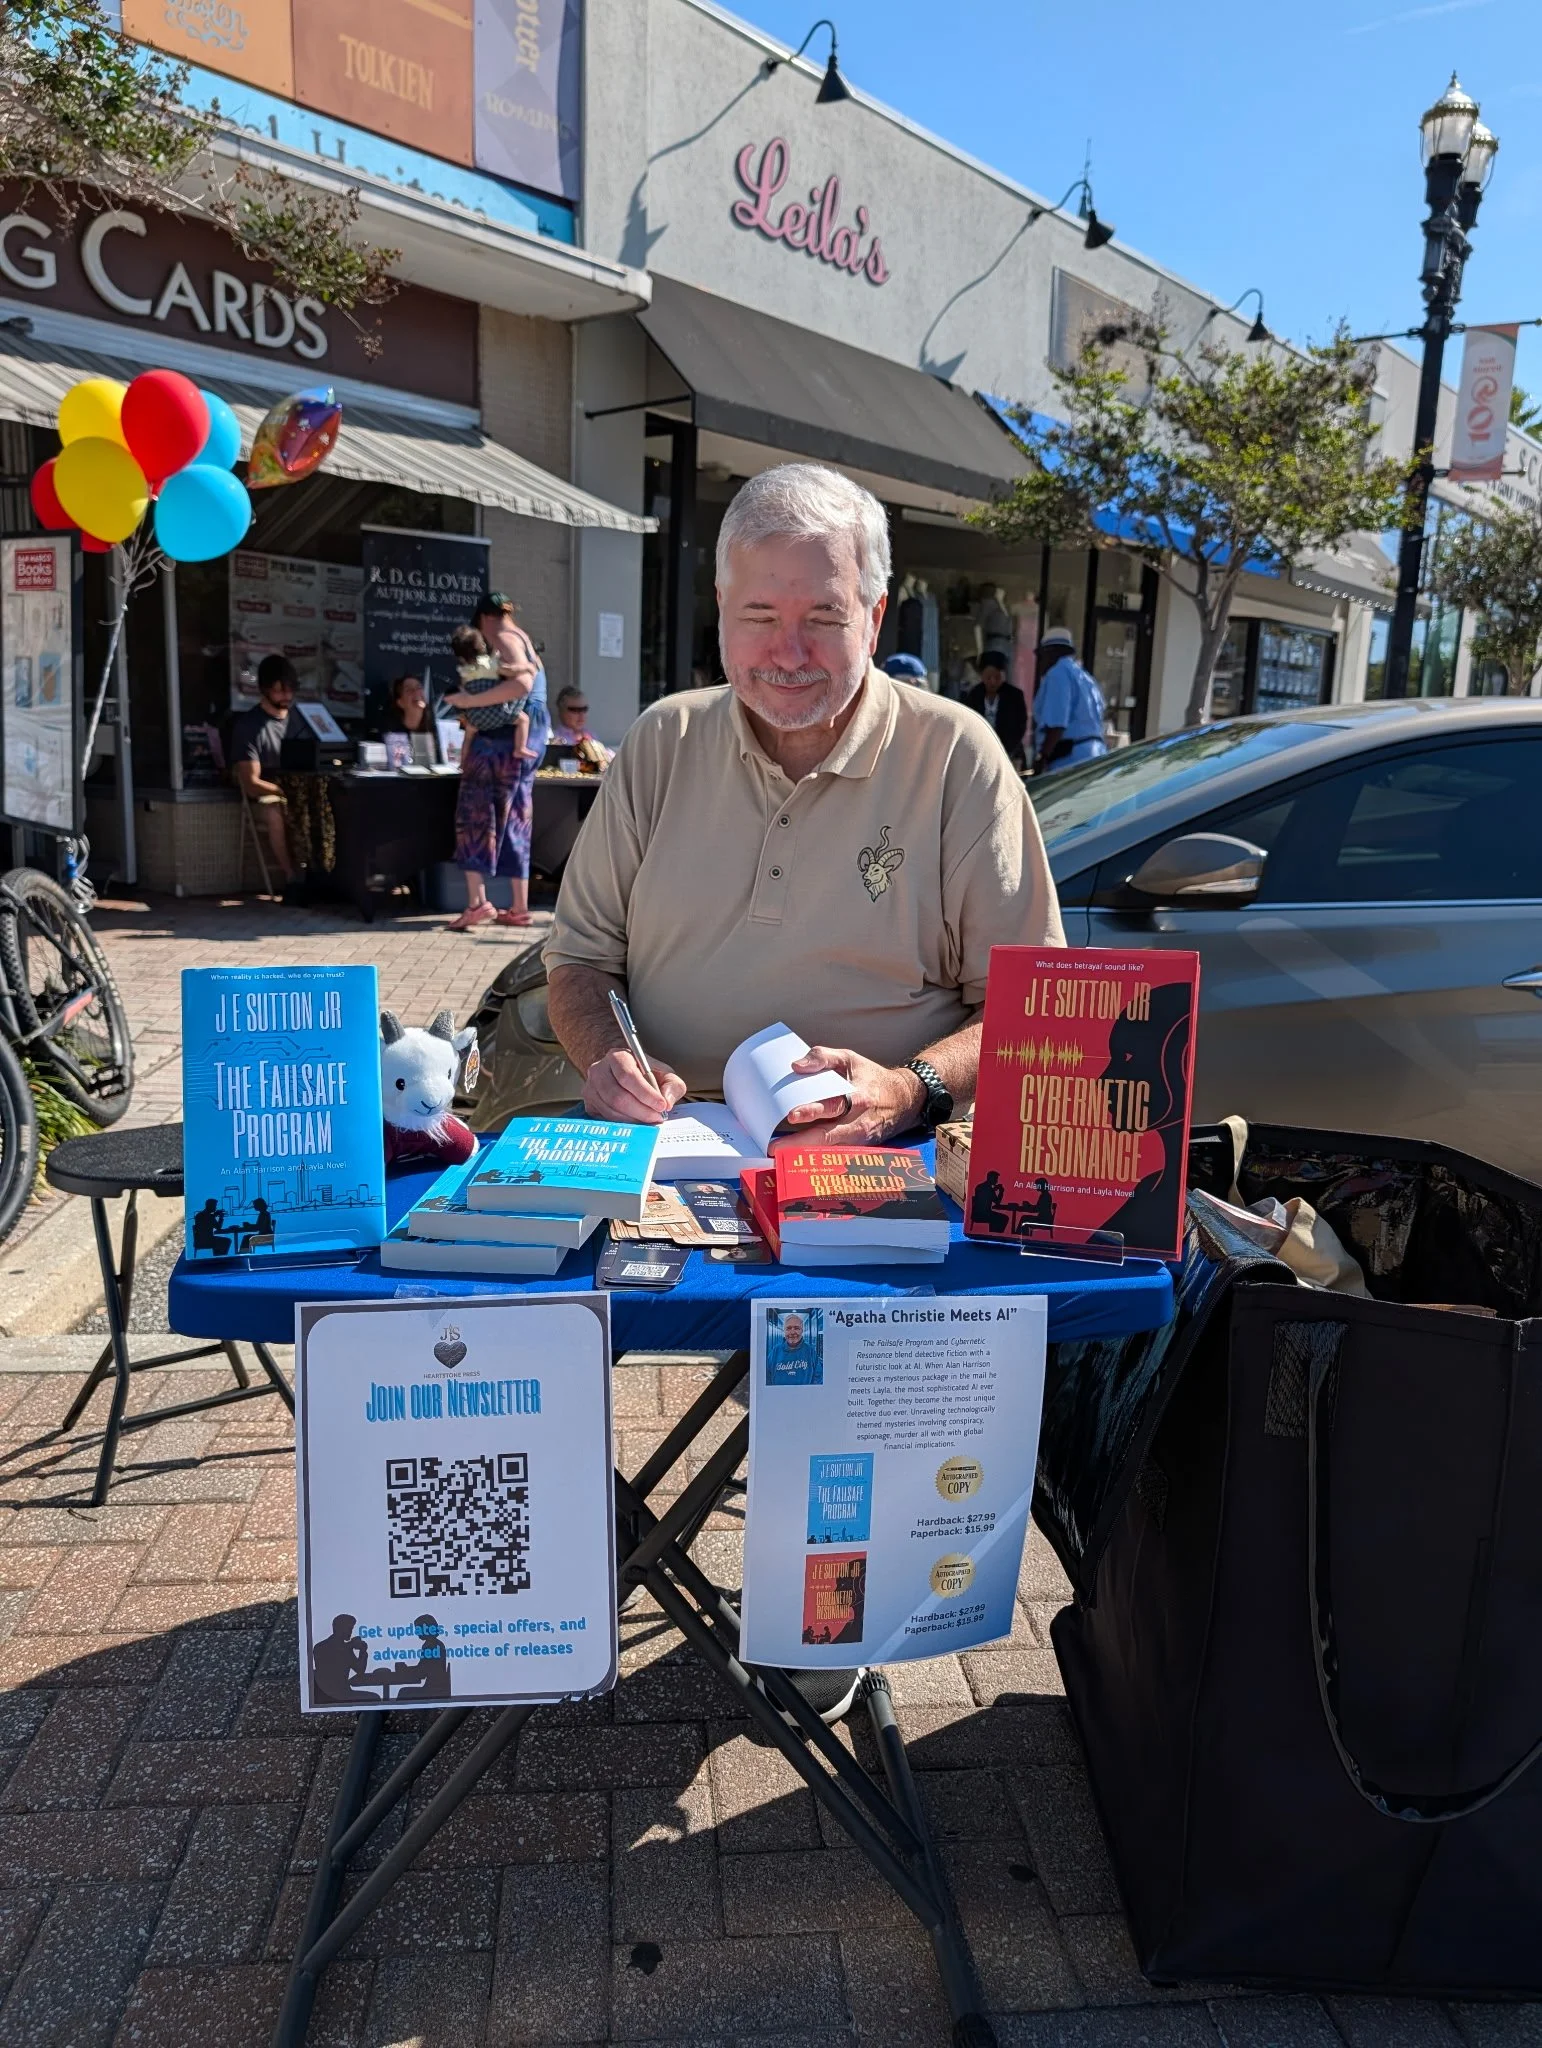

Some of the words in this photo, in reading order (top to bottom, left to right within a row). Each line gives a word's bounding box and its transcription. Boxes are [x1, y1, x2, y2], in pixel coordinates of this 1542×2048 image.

[338, 33, 435, 112] TOLKIEN
[731, 136, 891, 286] Leila's
[82, 210, 328, 359] CARDS
[18, 562, 52, 576] Books
[429, 572, 483, 592] LOVER
[1074, 962, 1102, 971] betrayal
[1025, 978, 1037, 1016] J
[1041, 979, 1051, 1016] E
[1055, 979, 1122, 1020] SUTTON
[1127, 982, 1151, 1021] JR
[216, 994, 226, 1033] J
[233, 994, 241, 1031] E
[246, 992, 313, 1031] SUTTON
[320, 991, 342, 1029] JR
[214, 1061, 252, 1110] THE
[260, 1060, 348, 1109] FAILSAFE
[1020, 1074, 1150, 1131] CYBERNETIC
[232, 1108, 332, 1158] PROGRAM
[519, 1137, 550, 1149] THE
[554, 1138, 629, 1153] FAILSAFE
[1019, 1124, 1145, 1183] RESONANCE
[794, 1155, 803, 1166] J
[810, 1155, 817, 1165] E
[823, 1154, 884, 1166] SUTTON
[891, 1156, 913, 1168] JR
[253, 1166, 284, 1174] Harrison
[288, 1164, 301, 1172] and
[810, 1175, 906, 1189] CYBERNETIC
[1044, 1183, 1074, 1192] Harrison
[1094, 1188, 1112, 1196] Layla
[891, 1309, 946, 1323] Christie
[950, 1308, 992, 1322] Meets
[877, 1340, 903, 1348] Failsafe
[905, 1339, 933, 1347] Program
[951, 1338, 986, 1346] Cybernetic
[884, 1375, 919, 1383] mysterious
[922, 1373, 948, 1381] package
[927, 1384, 969, 1393] sophisticated
[366, 1382, 405, 1422] JOIN
[411, 1384, 443, 1419] OUR
[447, 1379, 541, 1418] NEWSLETTER
[868, 1398, 895, 1407] Together
[911, 1408, 945, 1416] Unraveling
[948, 1405, 995, 1414] technologically
[884, 1420, 915, 1428] mysteries
[918, 1419, 947, 1427] involving
[964, 1428, 983, 1436] global
[915, 1441, 955, 1449] implications.
[948, 1482, 971, 1494] COPY
[917, 1516, 964, 1526] Hardback:
[967, 1513, 996, 1523] $27.99
[911, 1527, 962, 1539] Paperback:
[965, 1524, 994, 1534] $15.99
[911, 1611, 957, 1623] Hardback:
[359, 1625, 382, 1638] Get
[388, 1623, 448, 1640] updates,
[454, 1621, 502, 1637] special
[508, 1619, 554, 1634] offers,
[560, 1617, 586, 1631] and
[905, 1621, 954, 1635] Paperback:
[373, 1645, 441, 1660] advanced
[447, 1643, 489, 1658] notice
[495, 1643, 510, 1657] of
[514, 1641, 573, 1655] releases
